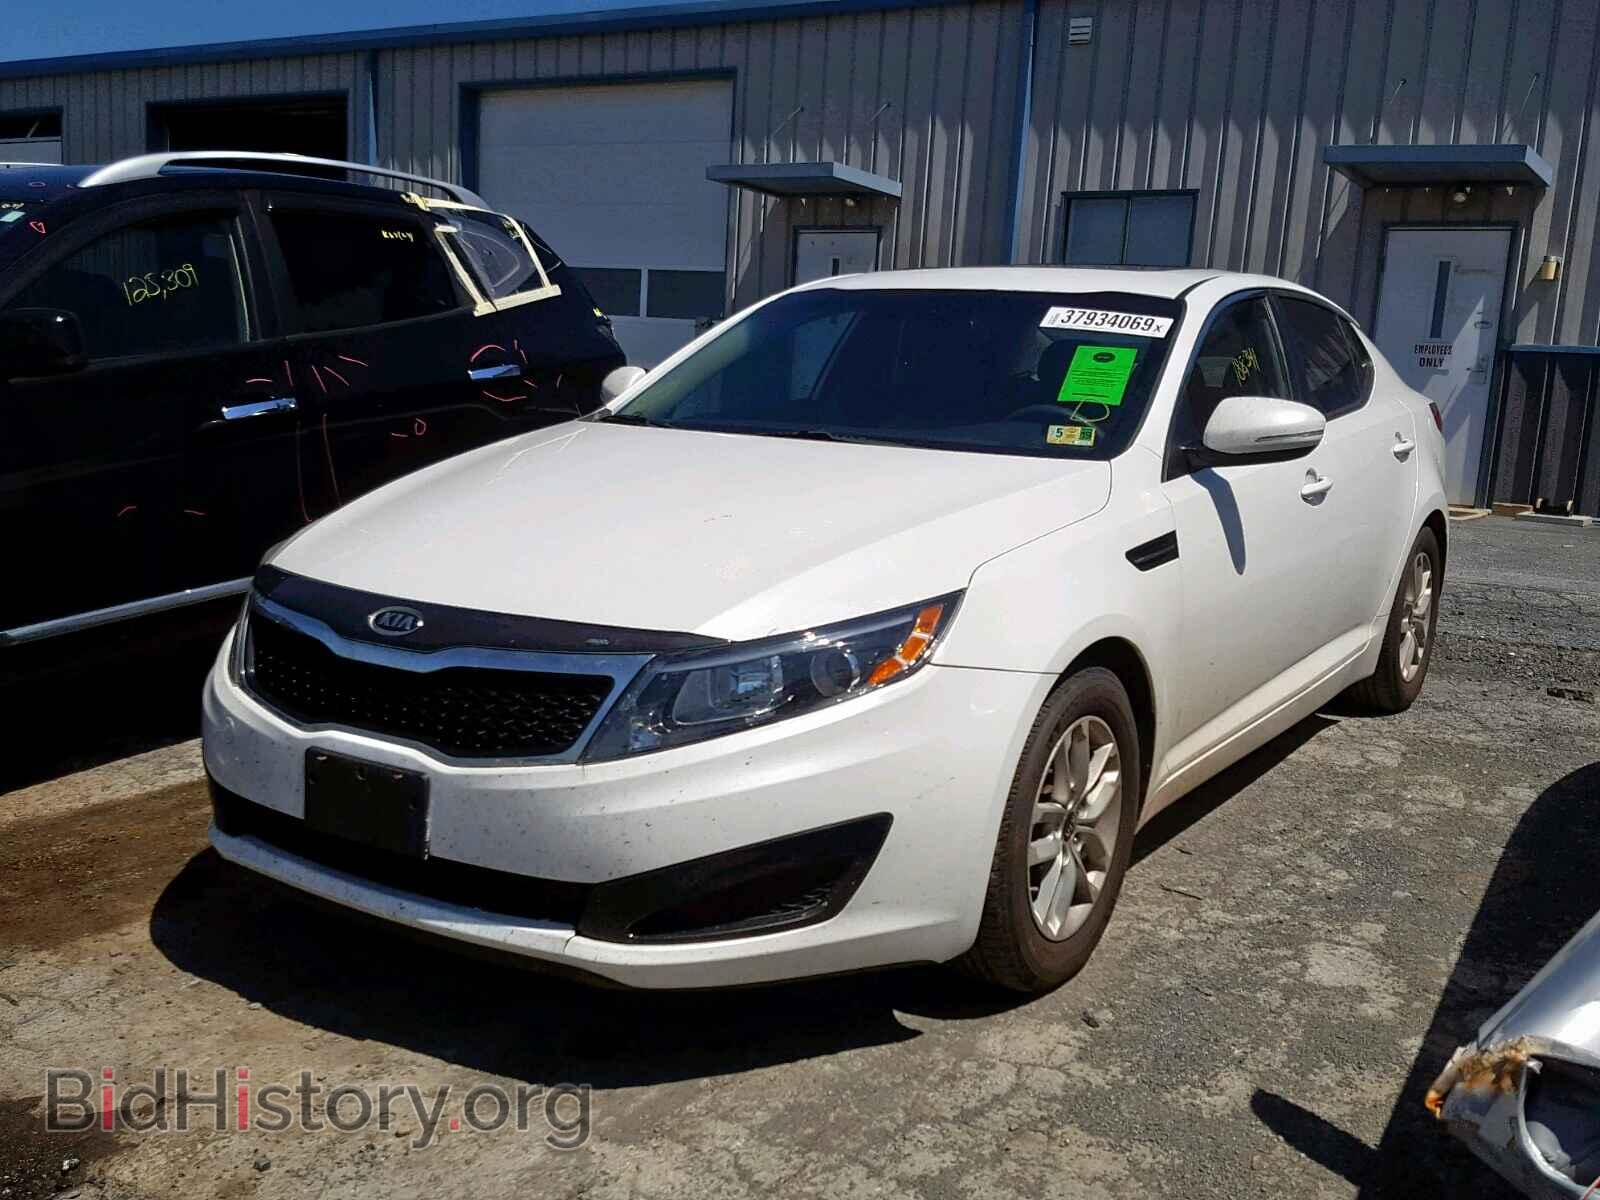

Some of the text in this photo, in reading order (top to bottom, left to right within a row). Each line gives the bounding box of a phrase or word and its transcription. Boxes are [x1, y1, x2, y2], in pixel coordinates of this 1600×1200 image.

[122, 263, 199, 306] 125,309
[1414, 344, 1453, 355] EMPLOYEES
[1419, 357, 1445, 368] ONLY
[1056, 427, 1063, 438] 5
